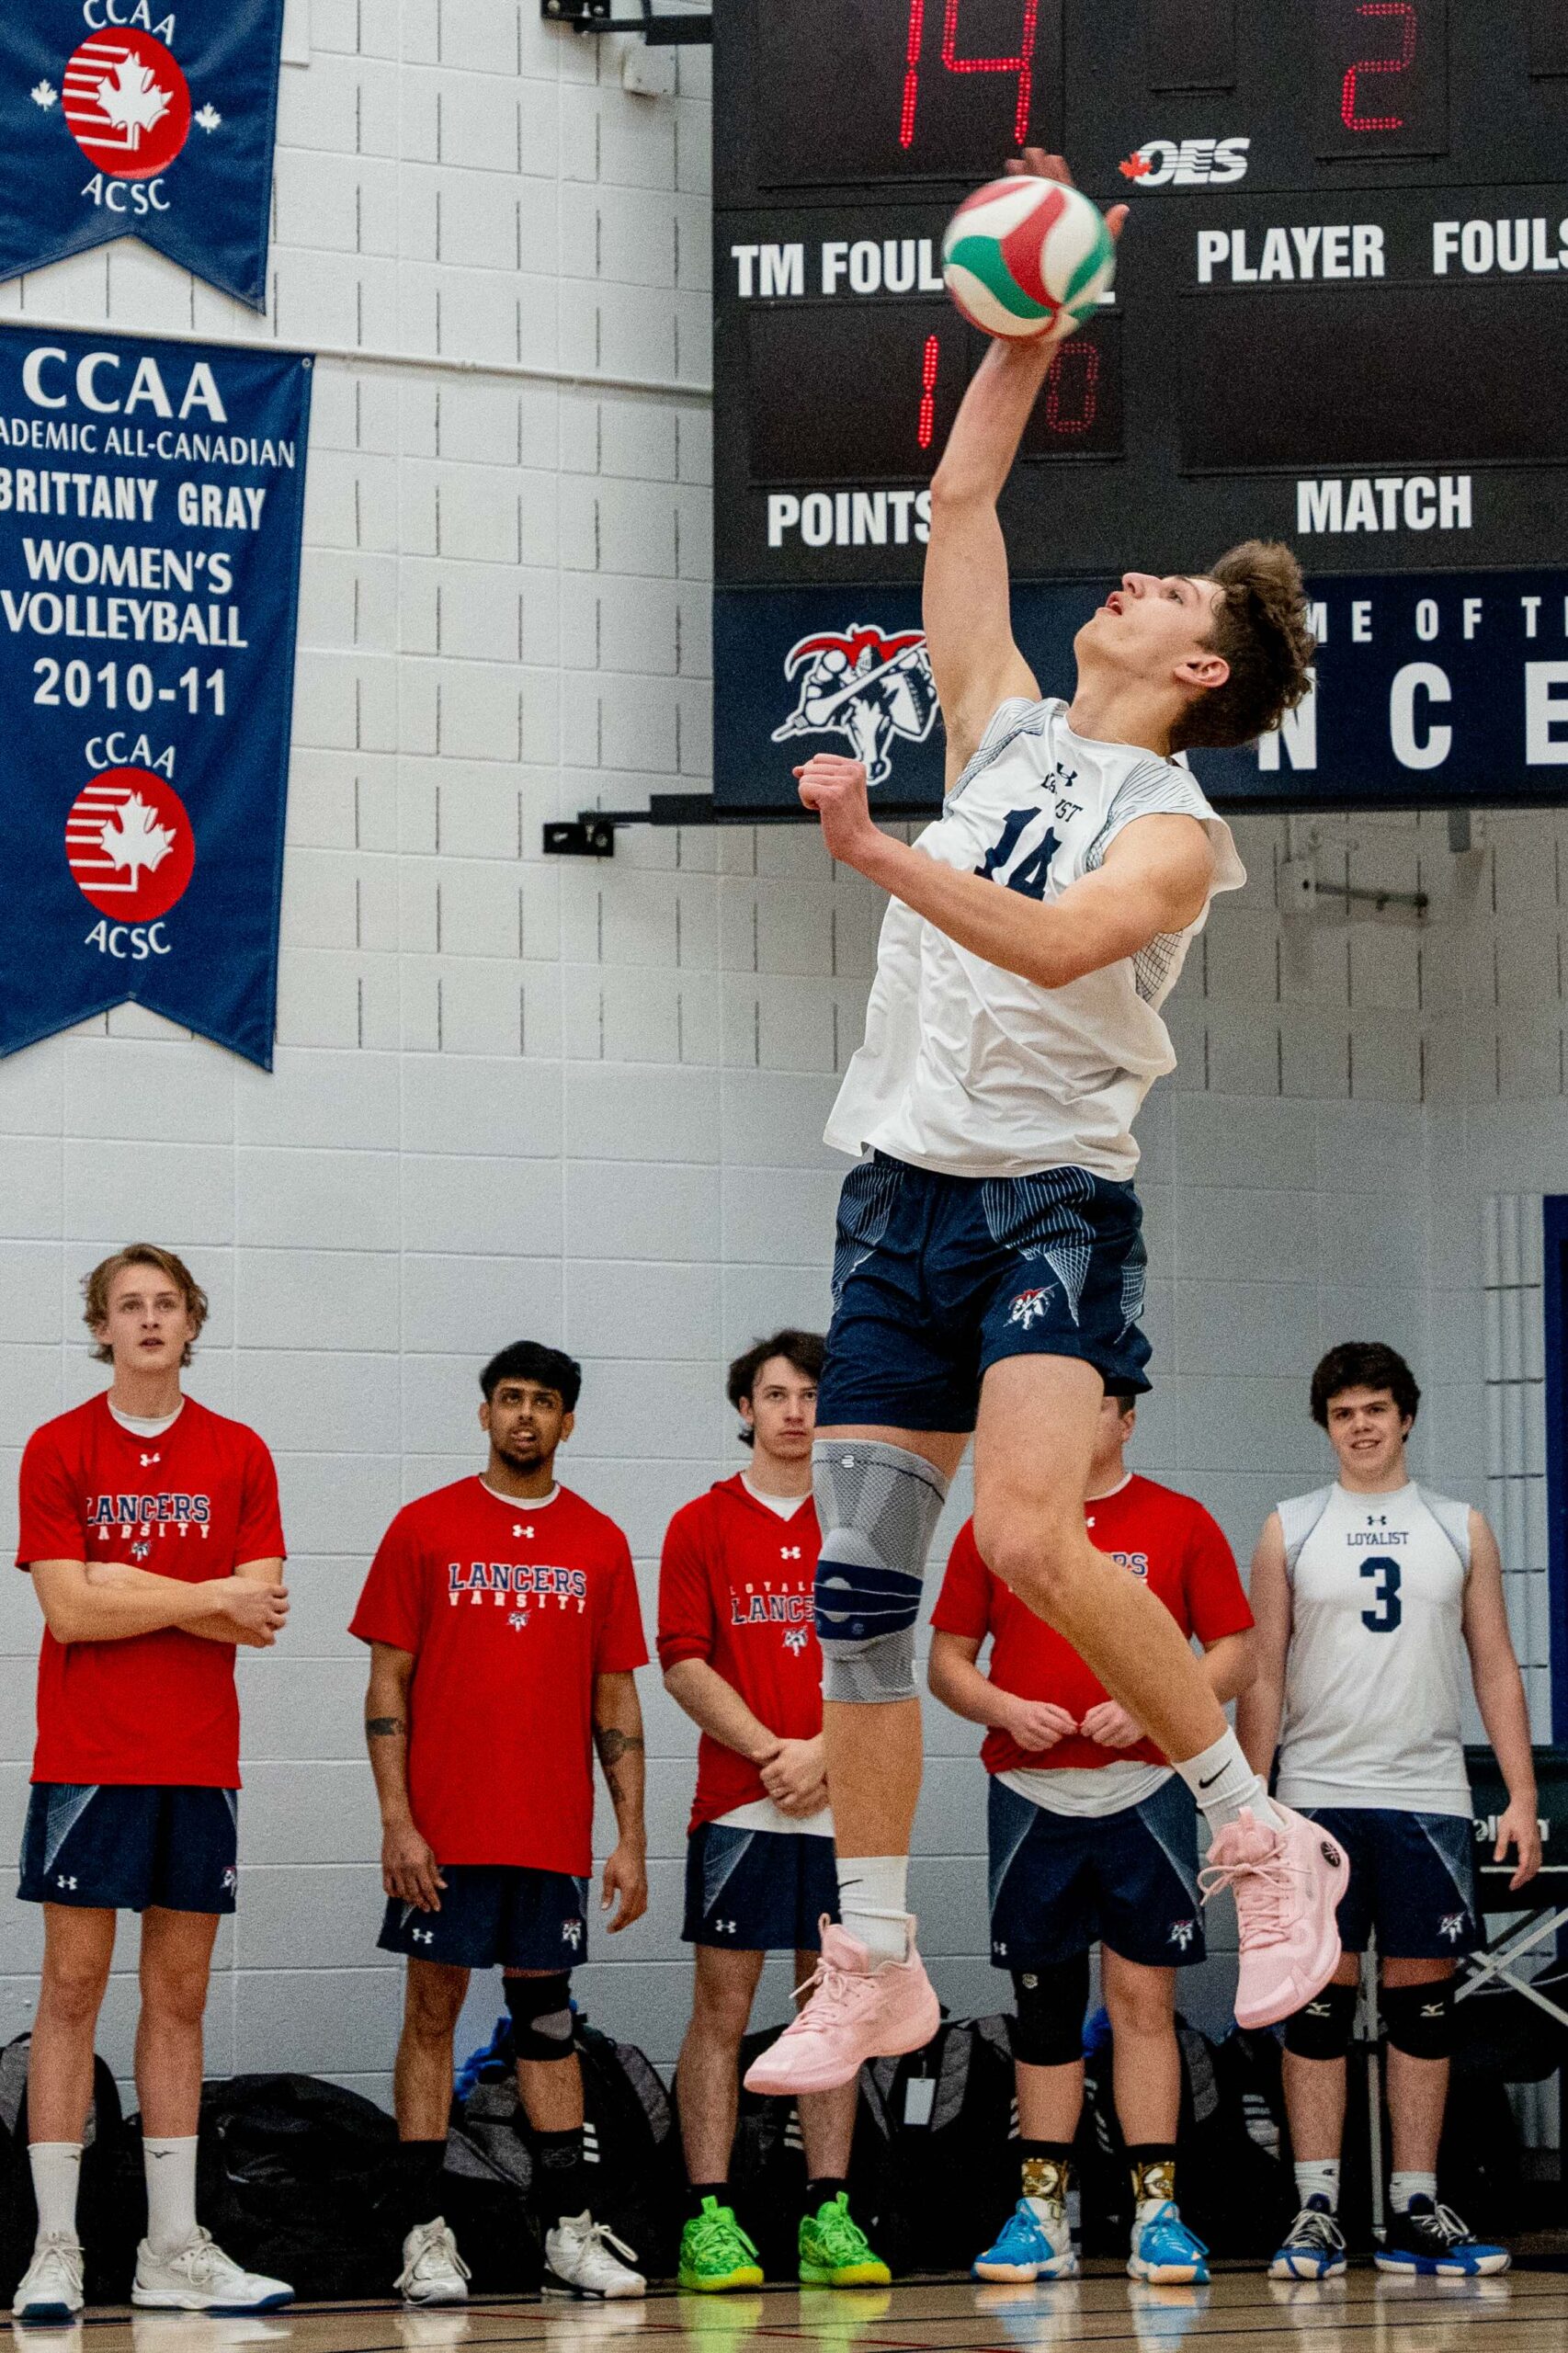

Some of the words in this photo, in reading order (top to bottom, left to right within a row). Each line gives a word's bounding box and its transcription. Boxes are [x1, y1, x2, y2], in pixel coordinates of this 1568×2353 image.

[83, 0, 176, 46] CCAA
[1342, 3, 1416, 131] 2
[1134, 137, 1251, 187] OES
[82, 172, 171, 215] ACSC
[731, 243, 804, 298] TM
[823, 238, 946, 295] FOUL
[1197, 223, 1386, 284] PLAYER
[22, 347, 228, 423] CCAA
[104, 426, 296, 470] ALL-CANADIAN
[0, 466, 159, 523] BRITTANY
[176, 481, 267, 531] GRAY
[1296, 474, 1471, 534] MATCH
[22, 538, 233, 596] WOMEN'S
[0, 589, 249, 648] VOLLEYBALL
[1415, 597, 1483, 642] OF
[32, 657, 226, 716] 2010-11
[85, 731, 177, 779] CCAA
[85, 919, 173, 960] ACSC
[97, 1522, 210, 1540] ARSITY
[1346, 1531, 1409, 1546] LOYALIST
[448, 1562, 586, 1598] LANCERS
[449, 1590, 586, 1614] VARSITY
[1359, 1556, 1402, 1632] 3
[731, 1595, 815, 1626] LANCE
